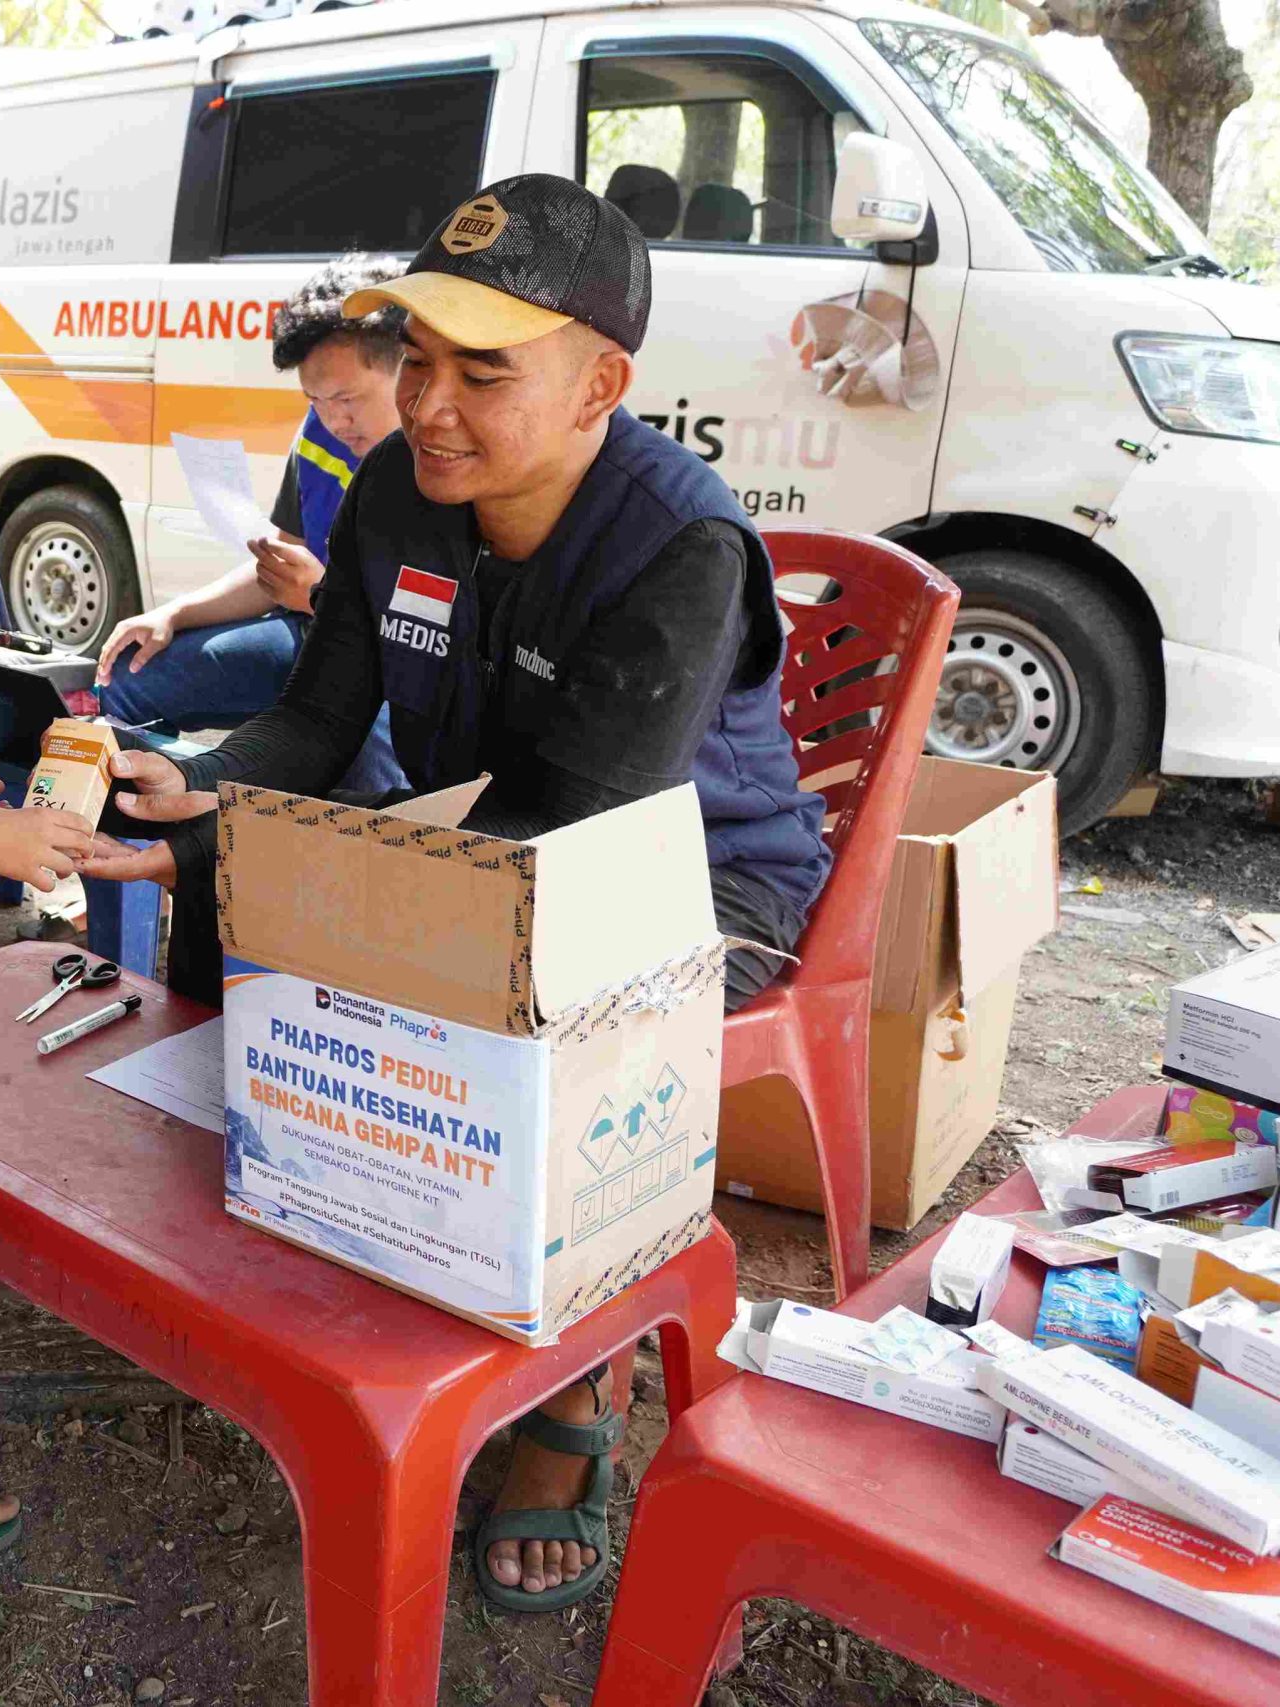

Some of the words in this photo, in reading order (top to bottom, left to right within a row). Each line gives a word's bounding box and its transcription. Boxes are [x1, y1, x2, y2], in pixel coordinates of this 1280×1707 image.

[58, 235, 114, 255] tengah
[379, 614, 451, 657] MEDIS
[515, 644, 556, 681] mdmc
[332, 991, 385, 1016] Danantara
[332, 1003, 383, 1028] Indonesia
[390, 1012, 447, 1043] Phapros
[270, 1017, 376, 1075] PHAPROS
[380, 1054, 468, 1105] PEDULI
[246, 1046, 346, 1104] BANTUAN
[351, 1086, 501, 1156] KESEHATAN
[249, 1078, 349, 1136] BENCANA
[355, 1118, 438, 1169] GEMPA
[444, 1151, 495, 1187] NTT
[281, 1124, 335, 1152] DUKUNGAN
[337, 1145, 414, 1182] OBAT-OBATAN,
[417, 1175, 463, 1201] VITAMIN,
[304, 1148, 350, 1172] SEMBAKO
[353, 1166, 375, 1182] DAN
[377, 1176, 421, 1200] HYGIENE
[423, 1192, 440, 1207] KIT
[248, 1162, 283, 1186] Program
[285, 1177, 328, 1204] Tanggung
[330, 1193, 359, 1215] Jawab
[360, 1206, 388, 1227] Sosial
[390, 1219, 408, 1235] dan
[410, 1224, 468, 1259] Lingkungan
[470, 1250, 501, 1272] (TJSL)
[279, 1191, 361, 1233] #PhaprosituSehat
[363, 1226, 451, 1269] #SehatituPhapros
[1003, 1382, 1052, 1416] AMLODIPINE
[1052, 1409, 1091, 1439] BESILATE
[1076, 1371, 1175, 1430] AMLODIPINE
[1175, 1427, 1263, 1477] BESILATE
